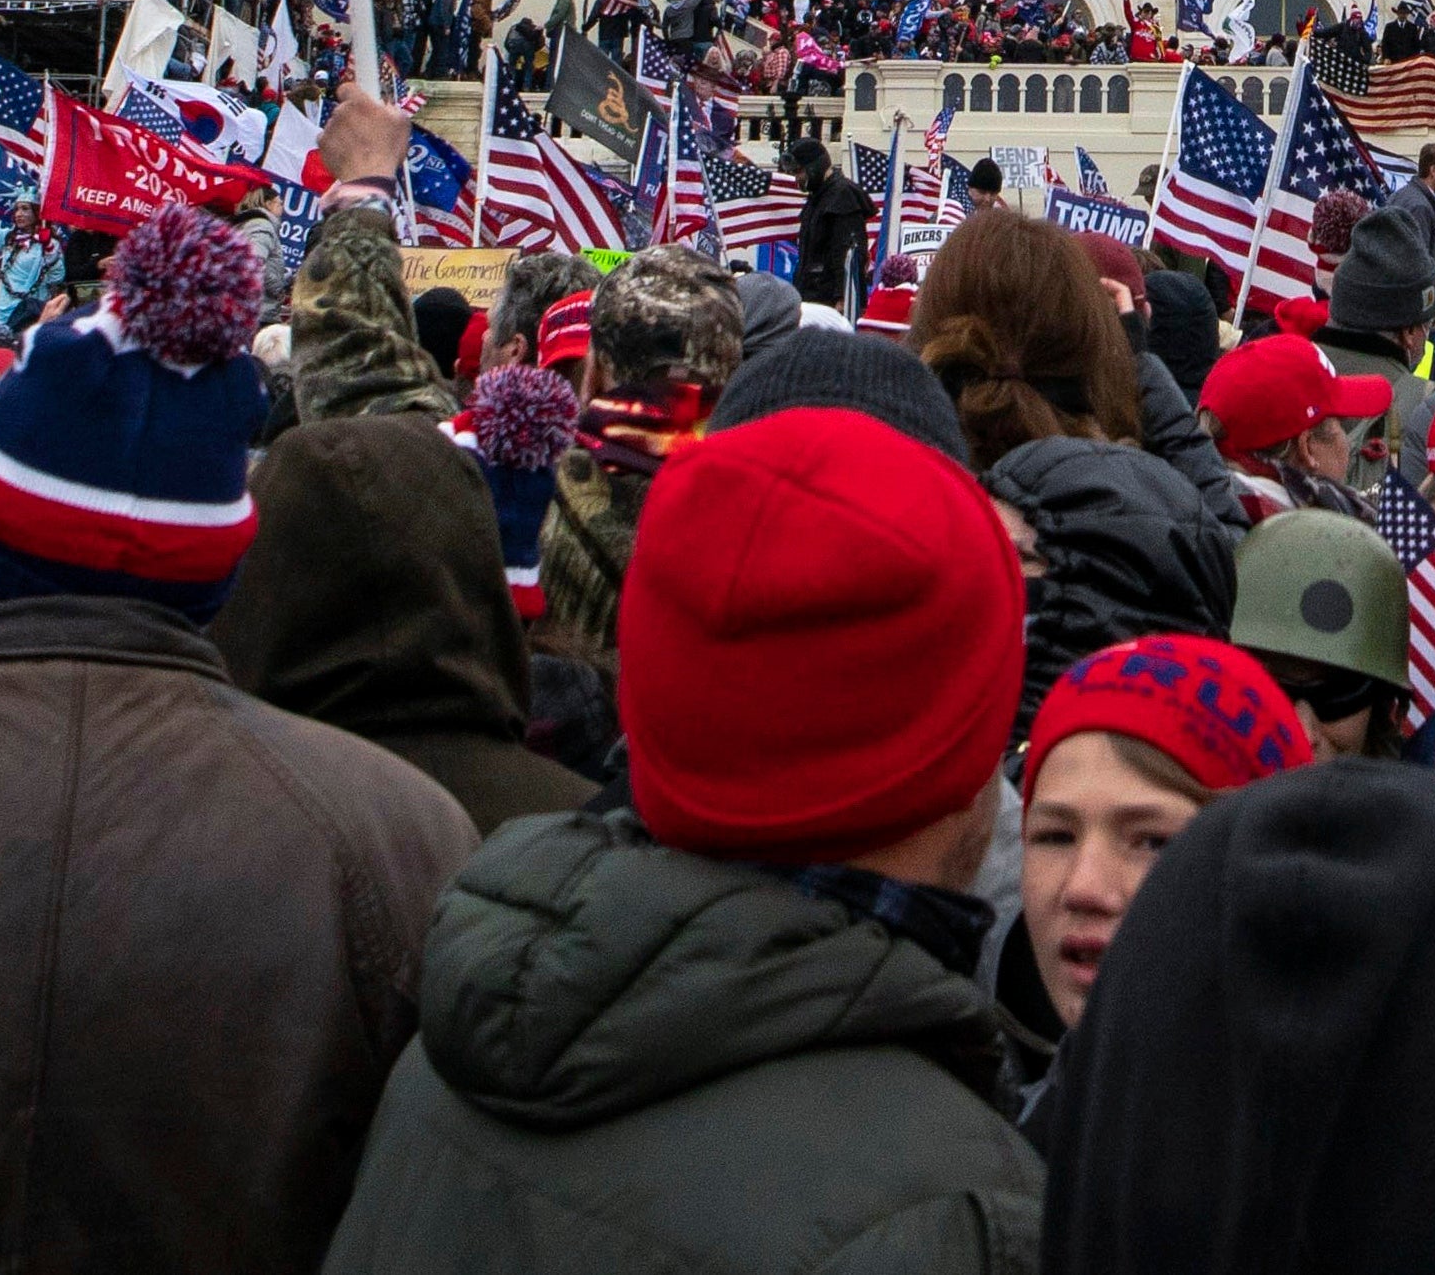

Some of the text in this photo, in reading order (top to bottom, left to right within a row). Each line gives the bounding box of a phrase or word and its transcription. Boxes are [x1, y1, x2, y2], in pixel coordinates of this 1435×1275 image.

[994, 147, 1040, 165] SEND
[1006, 176, 1041, 190] JAIL
[76, 185, 117, 207] KEEP
[1055, 197, 1147, 246] TRUMP
[904, 229, 942, 246] BIKERS
[406, 254, 431, 280] The
